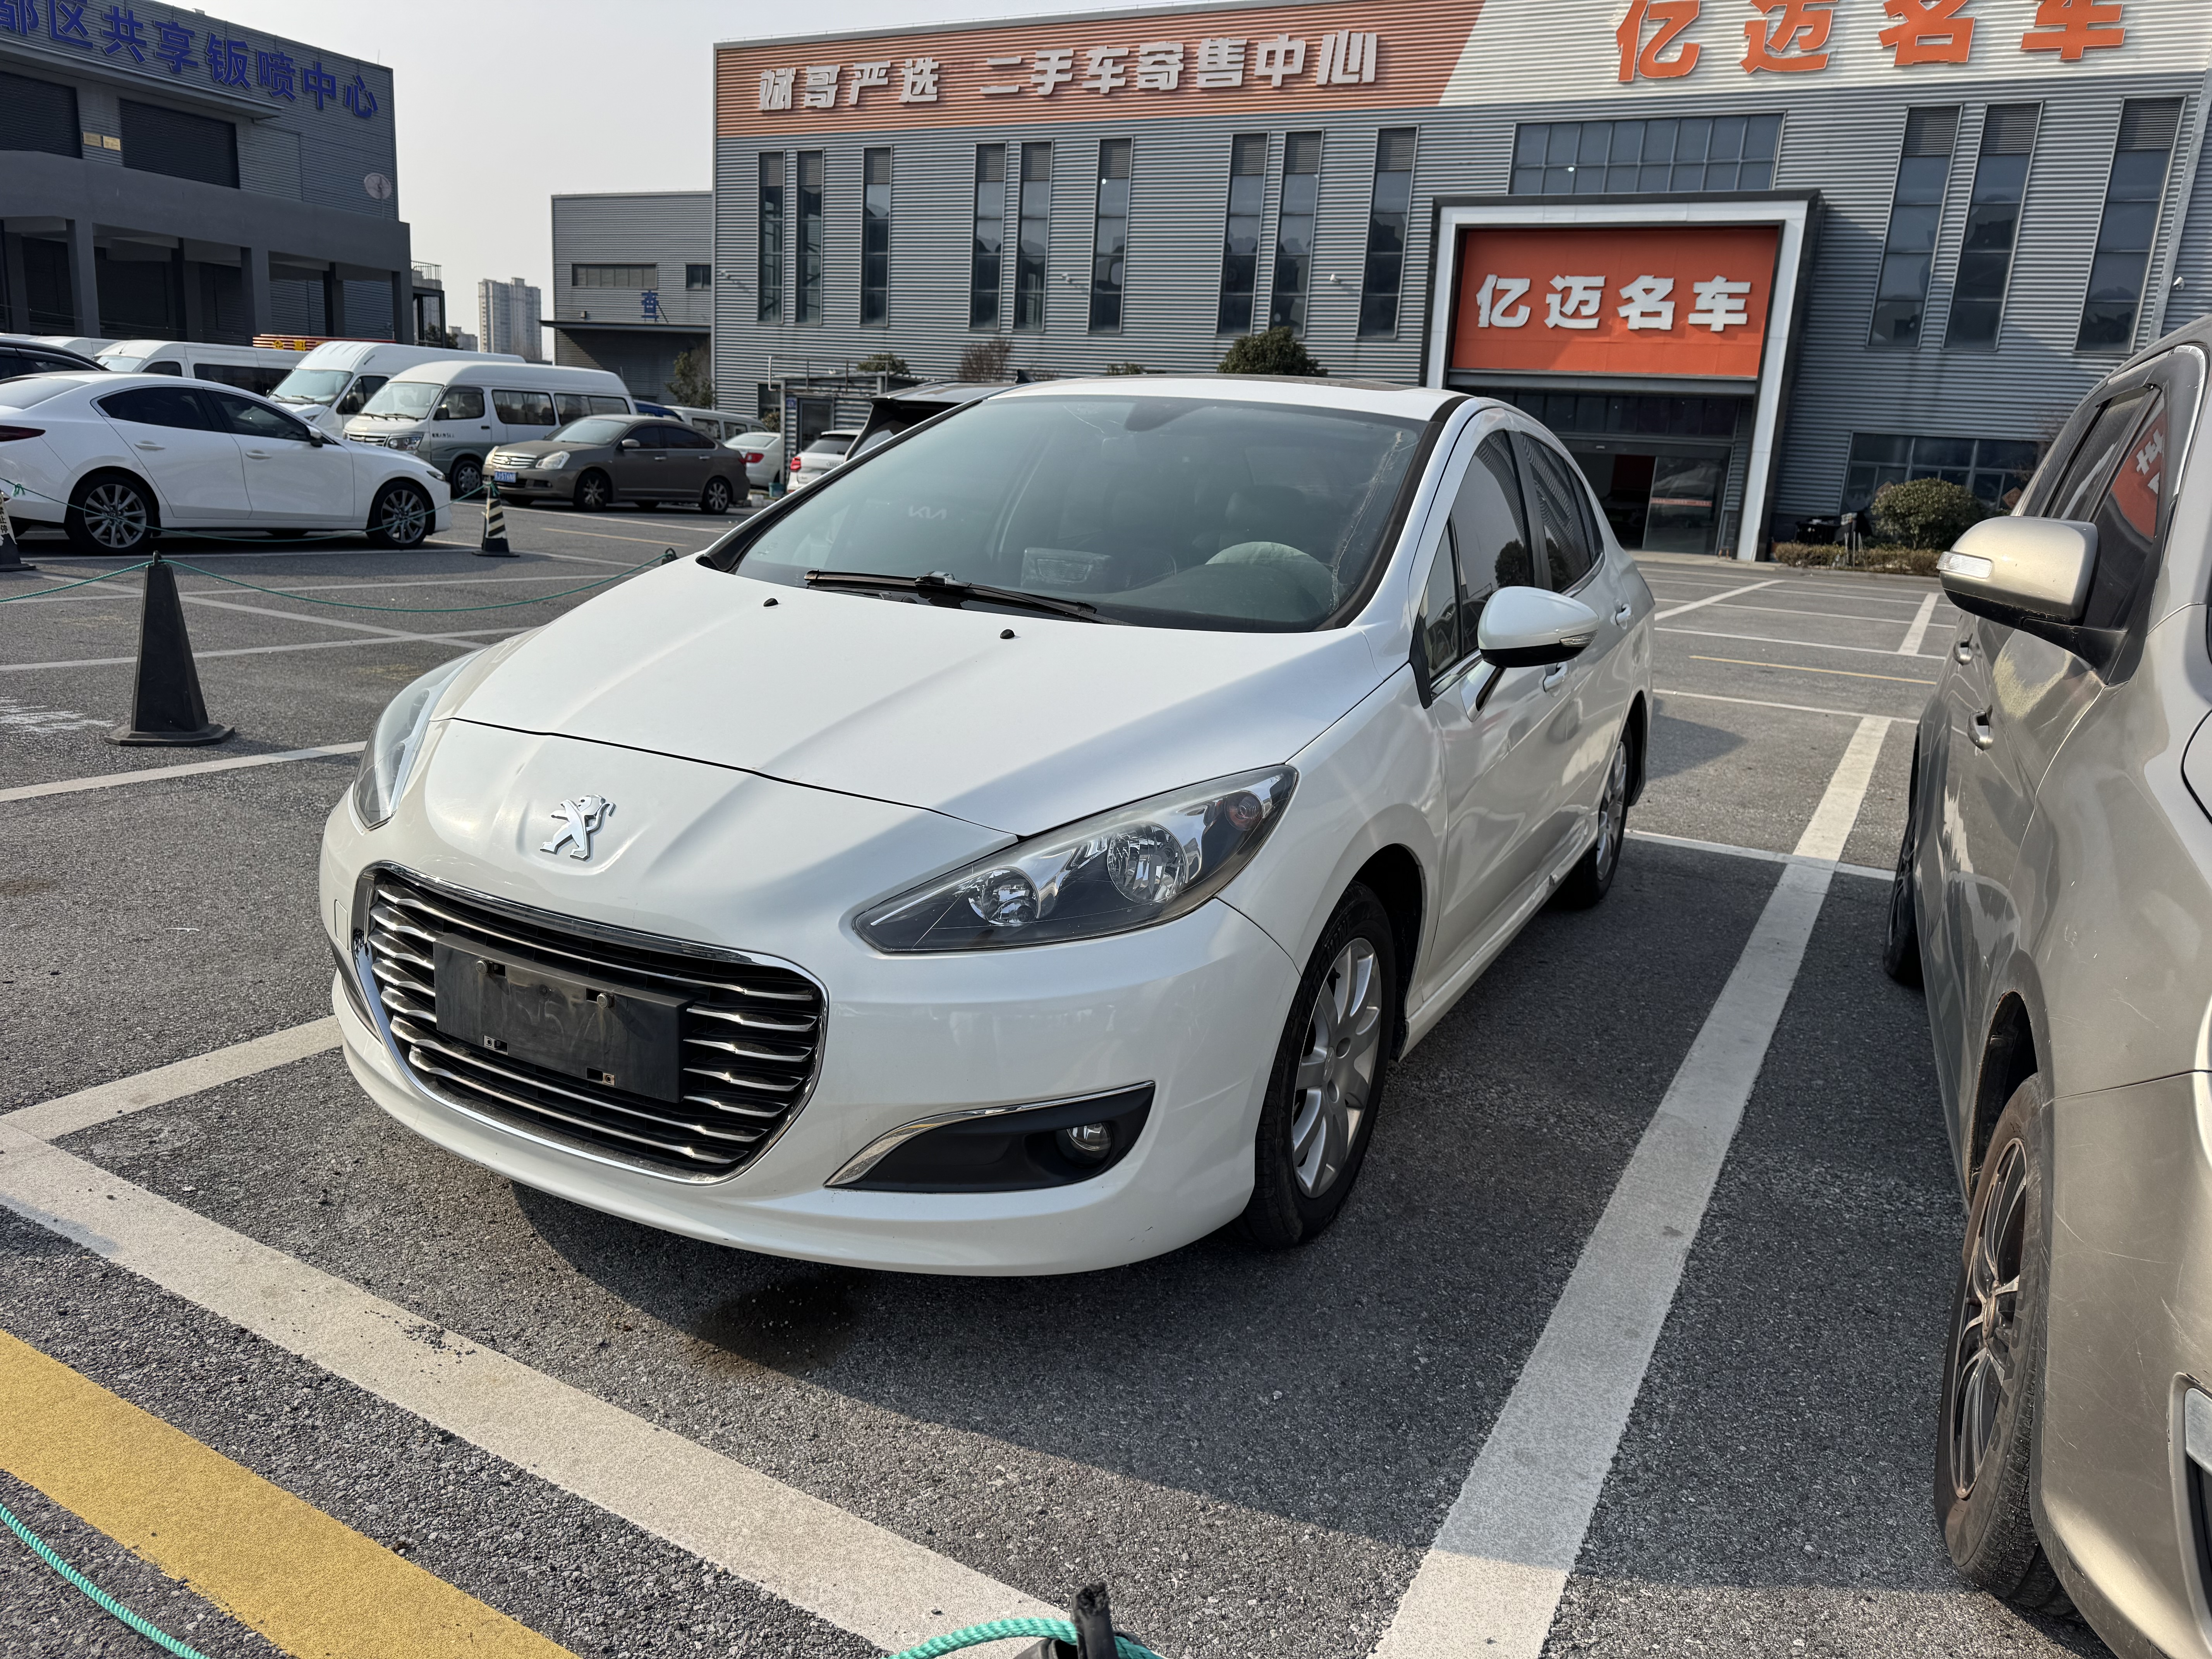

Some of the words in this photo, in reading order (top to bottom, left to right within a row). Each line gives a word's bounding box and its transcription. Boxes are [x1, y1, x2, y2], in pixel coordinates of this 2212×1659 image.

[758, 57, 939, 110] 斌哥严选
[980, 29, 1377, 95] 二手车寄售中心
[1615, 0, 2125, 82] 亿迈名车
[1476, 274, 1752, 332] 亿迈名车
